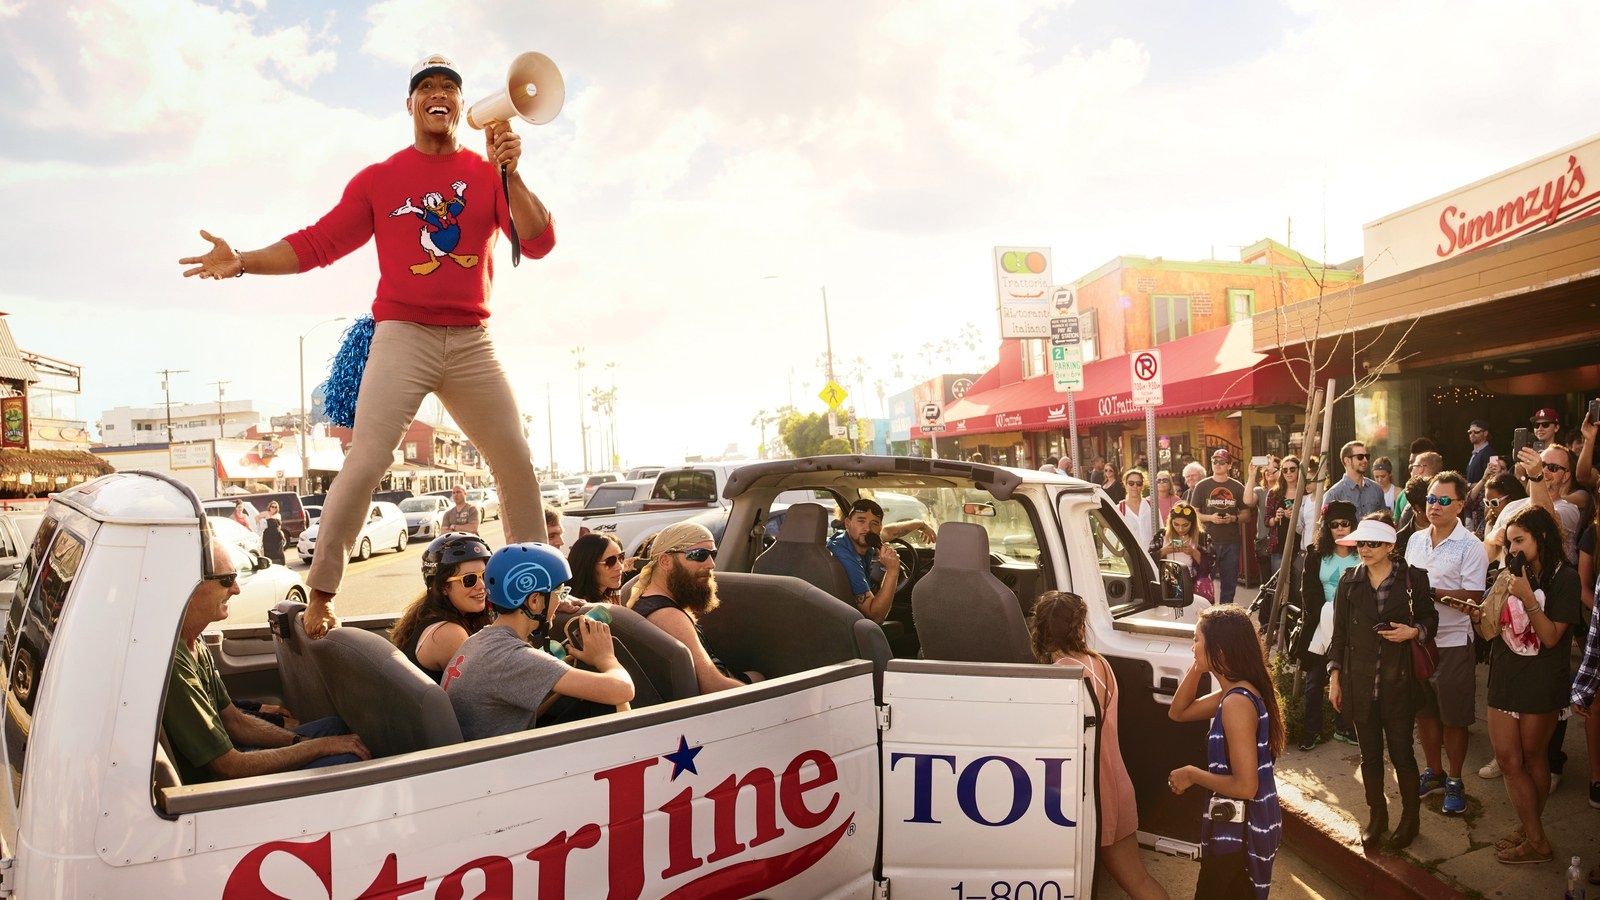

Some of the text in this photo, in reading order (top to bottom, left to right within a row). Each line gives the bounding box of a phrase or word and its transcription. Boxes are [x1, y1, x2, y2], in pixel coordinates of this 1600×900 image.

[1437, 155, 1585, 257] Simmzy's
[1001, 276, 1048, 288] Trattoria
[1012, 321, 1047, 333] Italiano
[1061, 332, 1080, 340] STATION
[1054, 361, 1081, 371] PARKING
